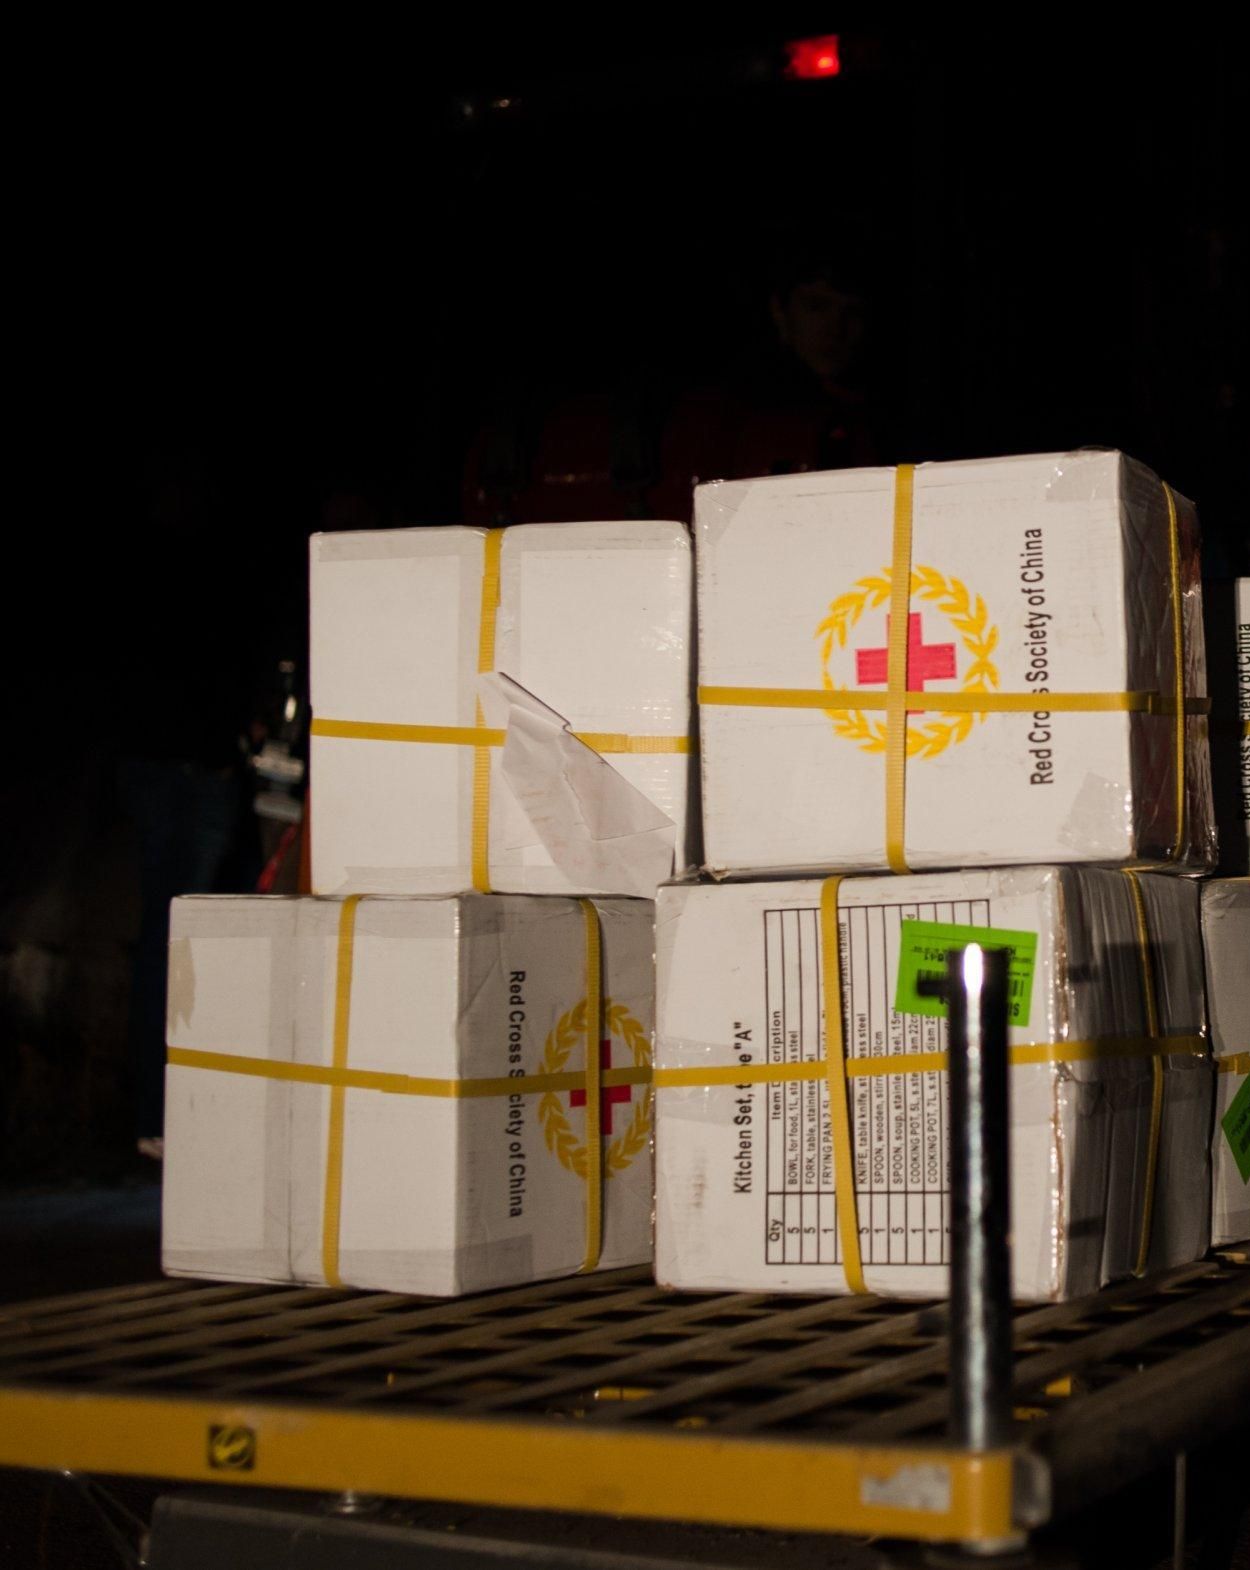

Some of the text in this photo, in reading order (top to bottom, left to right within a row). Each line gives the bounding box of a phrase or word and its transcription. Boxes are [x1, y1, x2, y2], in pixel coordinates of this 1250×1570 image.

[1020, 529, 1054, 785] Red Cros Society of China
[788, 1031, 798, 1052] steel
[892, 1033, 902, 1055] teel,
[910, 1037, 919, 1053] iam
[926, 1028, 935, 1052] diam
[770, 1011, 784, 1120] Item Dcription
[505, 971, 526, 1218] Red Cross Sciety of China
[733, 1022, 754, 1193] Kitchen Set, te "A"
[788, 1098, 800, 1110] 1L,
[856, 1013, 869, 1184] KNIFE, table knife, stess steel
[893, 1076, 902, 1109] stainle
[910, 1098, 920, 1111] 5L,
[927, 1092, 938, 1107] 7L,
[788, 1113, 799, 1136] food,
[875, 1101, 884, 1142] wooden,
[894, 1111, 906, 1140] soup,
[910, 1113, 921, 1135] POT,
[927, 1110, 938, 1132] POT,
[788, 1139, 798, 1151] for
[805, 1125, 816, 1151] table,
[788, 1154, 800, 1185] BOWL,
[805, 1154, 817, 1185] FORK,
[822, 1146, 832, 1185] FRYING
[874, 1144, 884, 1184] SPOON,
[893, 1143, 904, 1184] SPOON,
[910, 1139, 920, 1183] COOKING
[928, 1136, 938, 1183] COOKING
[768, 1219, 784, 1242] Qty
